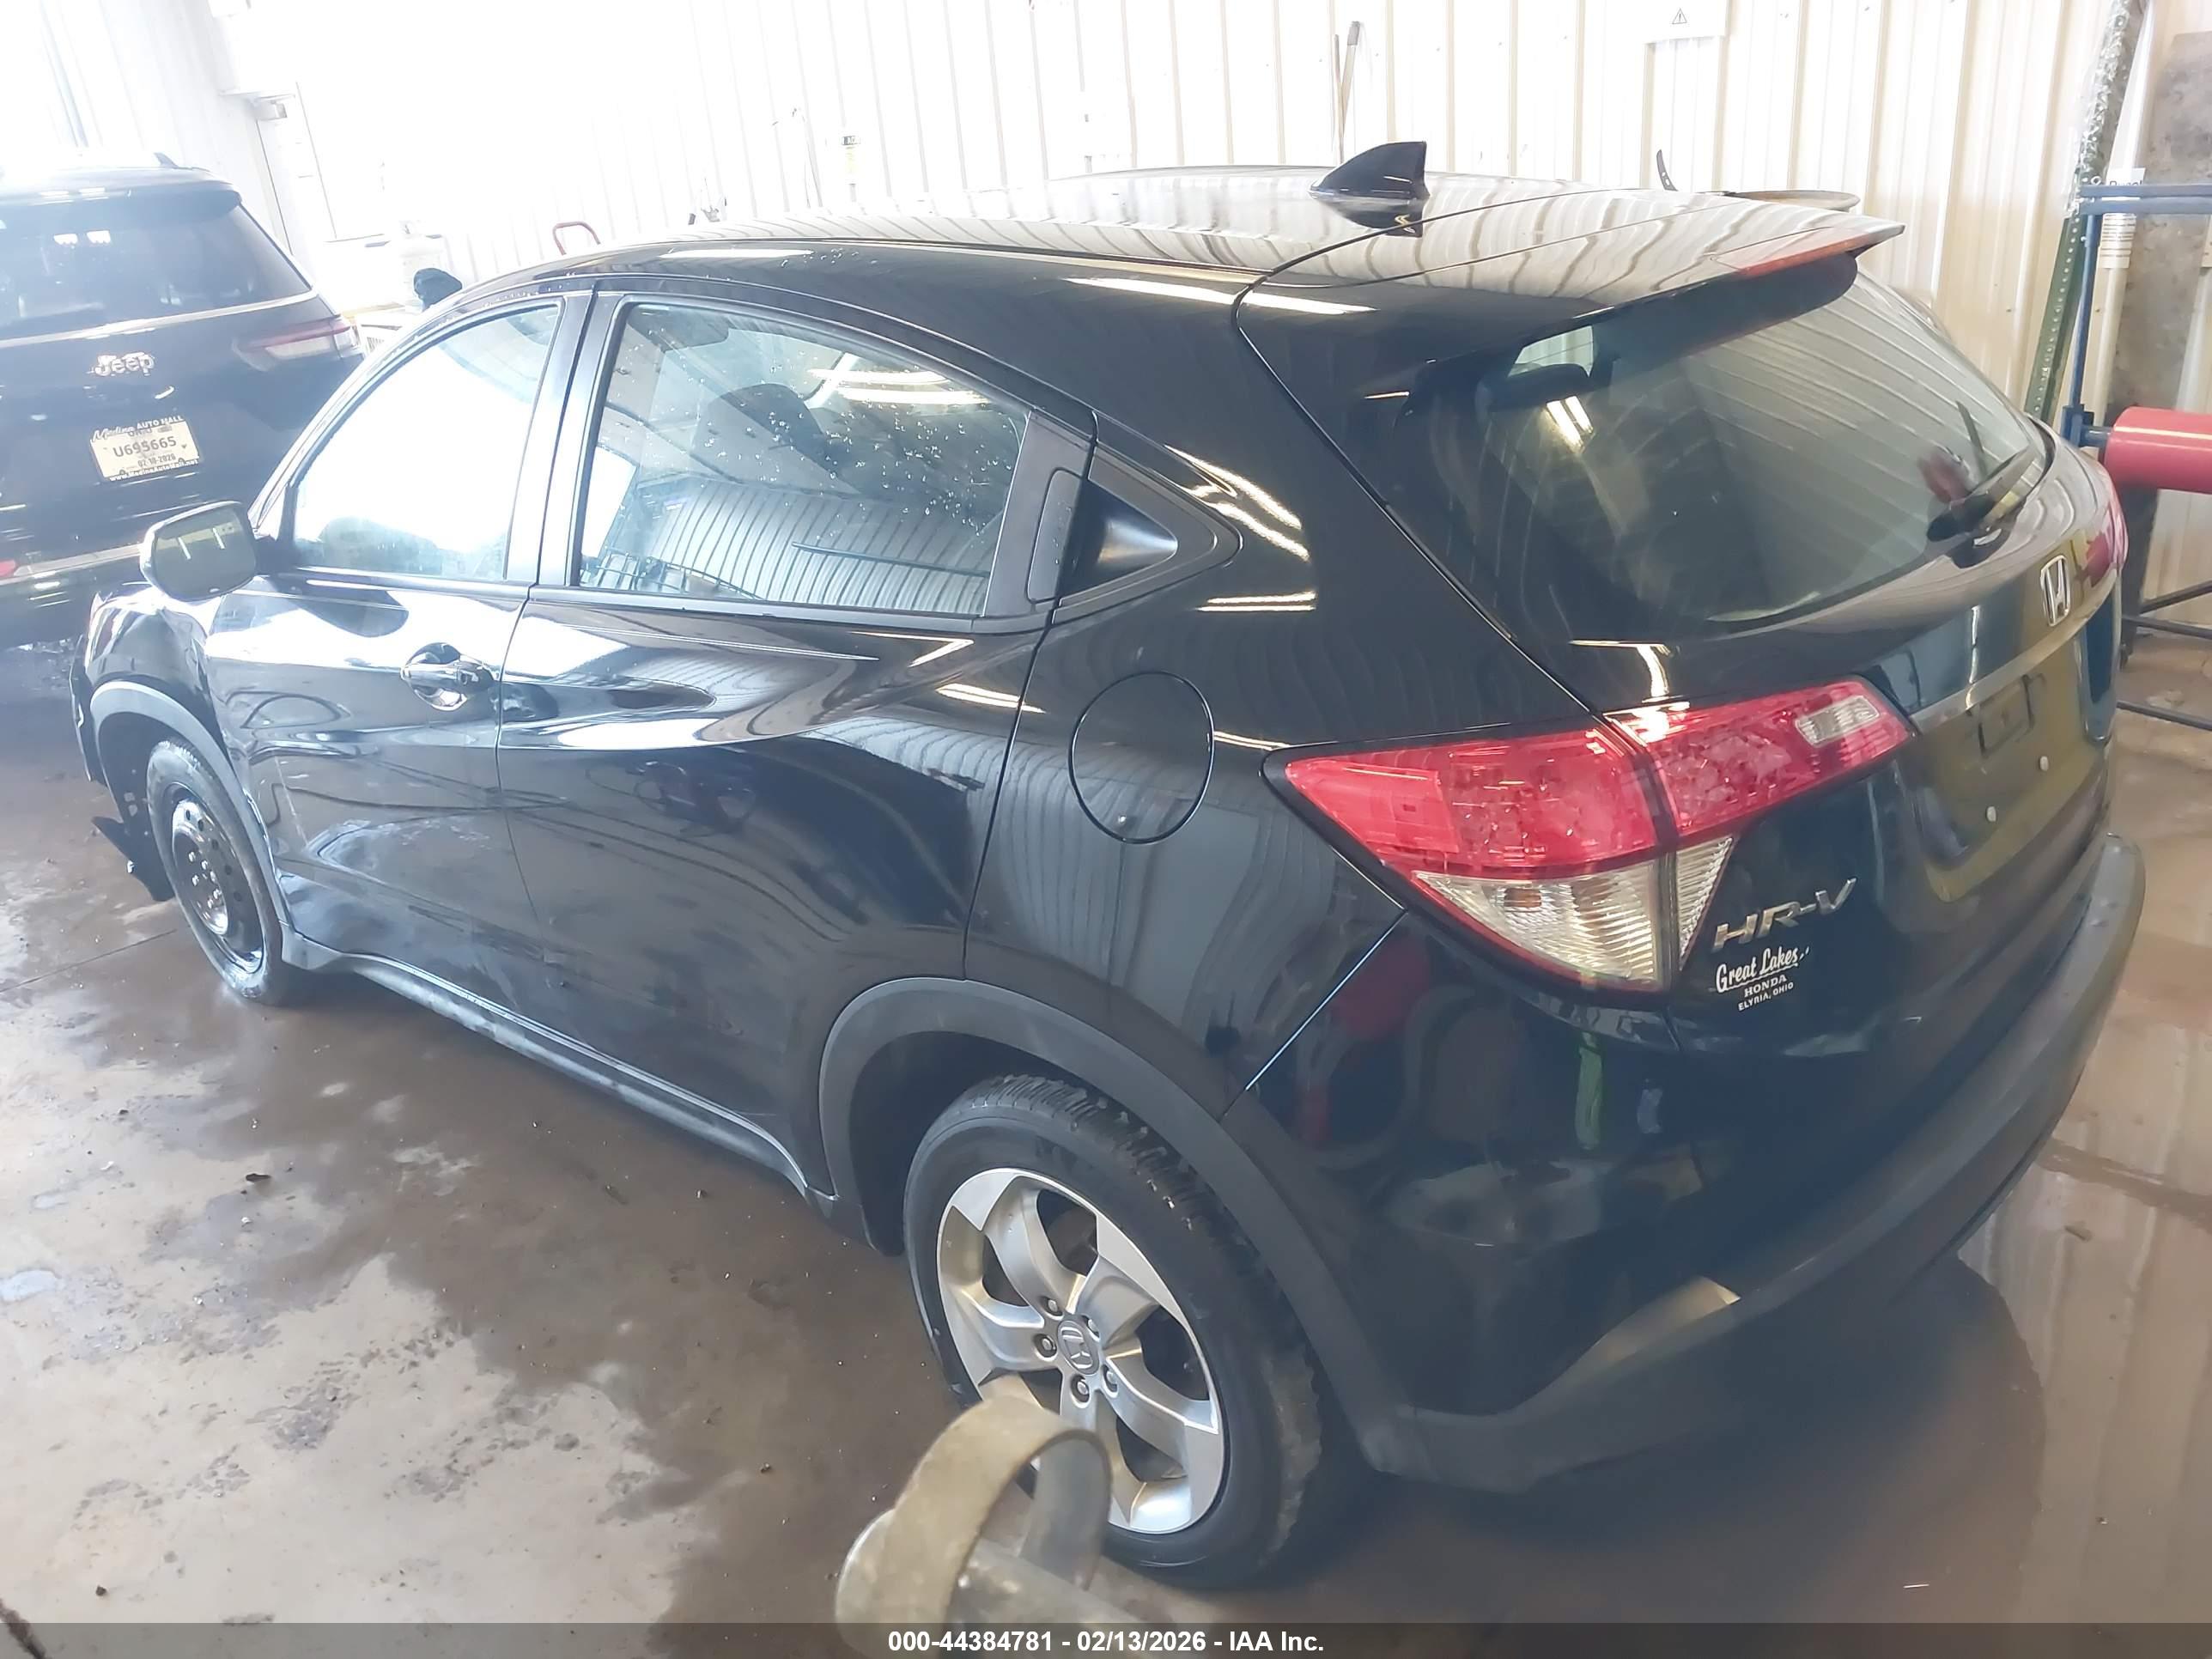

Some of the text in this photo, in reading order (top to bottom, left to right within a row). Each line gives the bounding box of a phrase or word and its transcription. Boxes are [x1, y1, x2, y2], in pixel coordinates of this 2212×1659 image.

[94, 351, 155, 377] Jeep
[137, 419, 160, 429] AUTO
[161, 415, 184, 424] MALL
[112, 435, 177, 458] U695665
[1712, 878, 1856, 951] HR-V
[1716, 945, 1799, 994] Great Lakes
[1738, 981, 1794, 1012] ELYRIA, OHIO
[1744, 974, 1787, 998] HONDA
